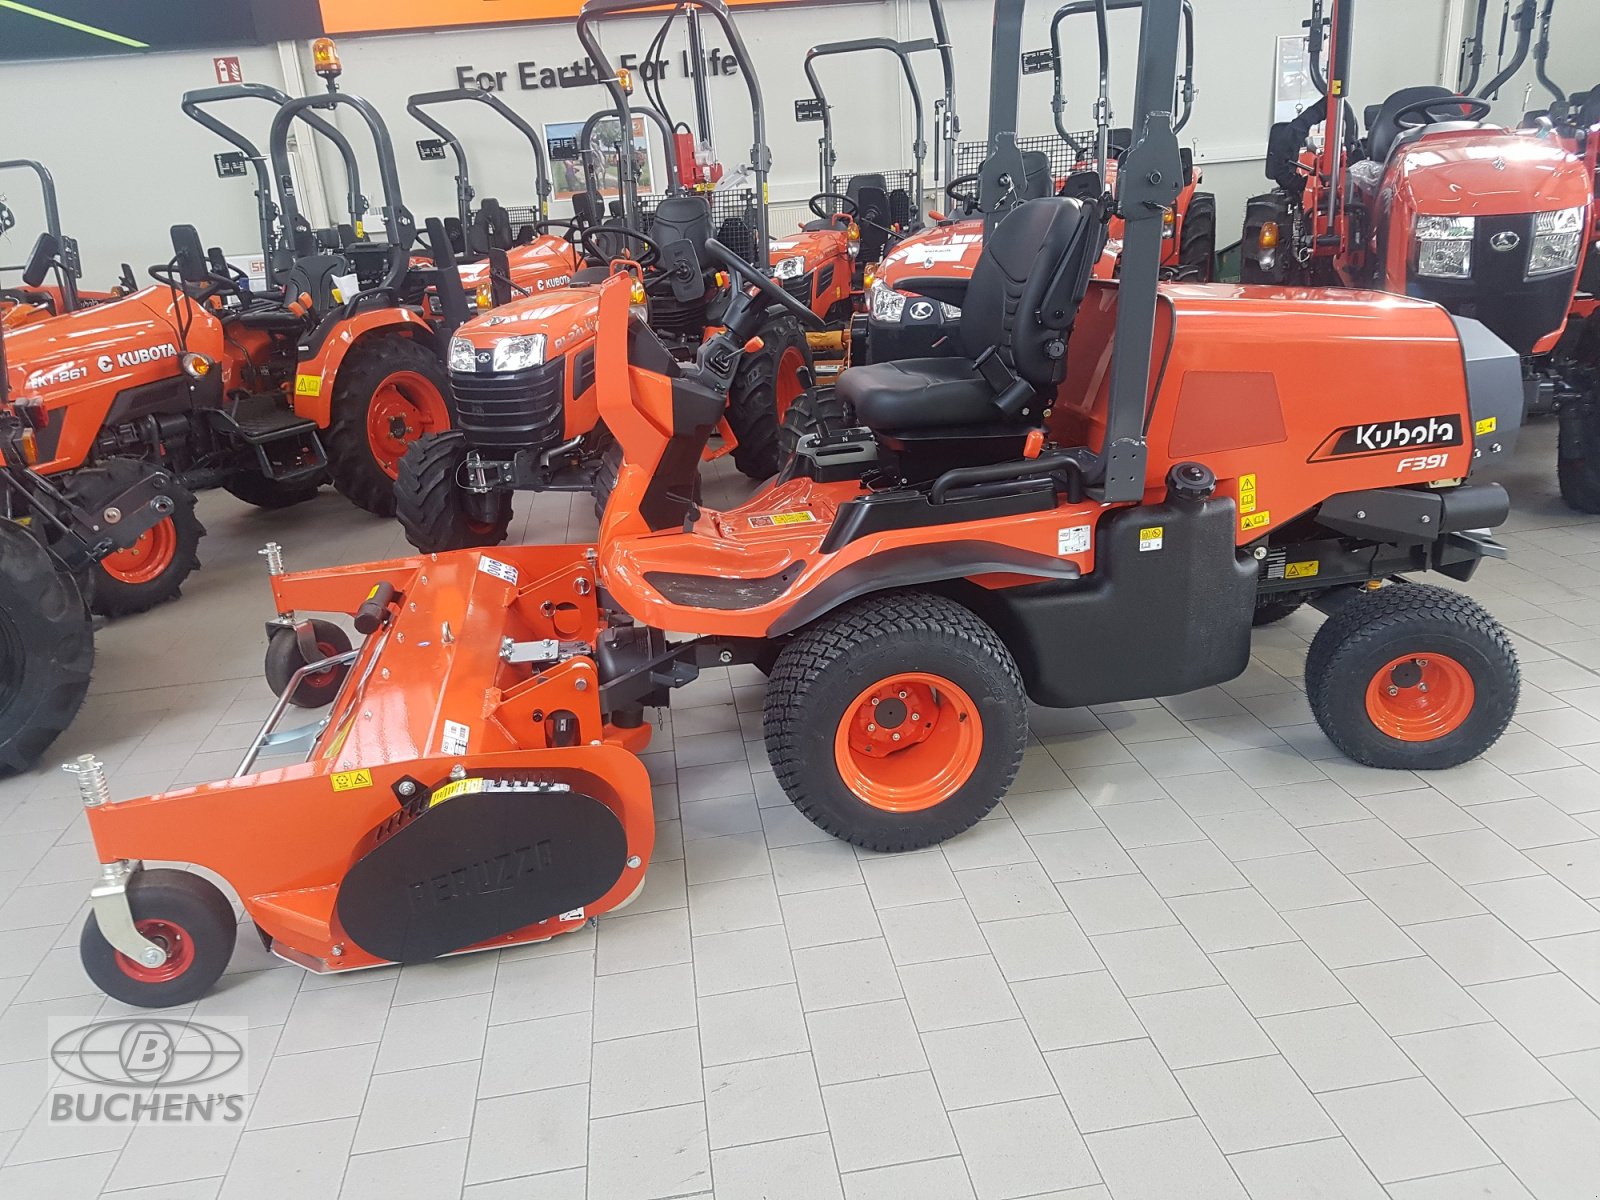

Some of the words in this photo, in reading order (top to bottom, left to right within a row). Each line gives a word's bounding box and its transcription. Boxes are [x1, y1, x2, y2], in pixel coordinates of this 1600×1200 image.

[456, 65, 507, 92] For
[518, 57, 600, 89] Earth
[620, 53, 669, 80] For
[117, 343, 177, 368] KUBOTA
[1356, 417, 1453, 449] Kubota
[1396, 453, 1449, 473] F391
